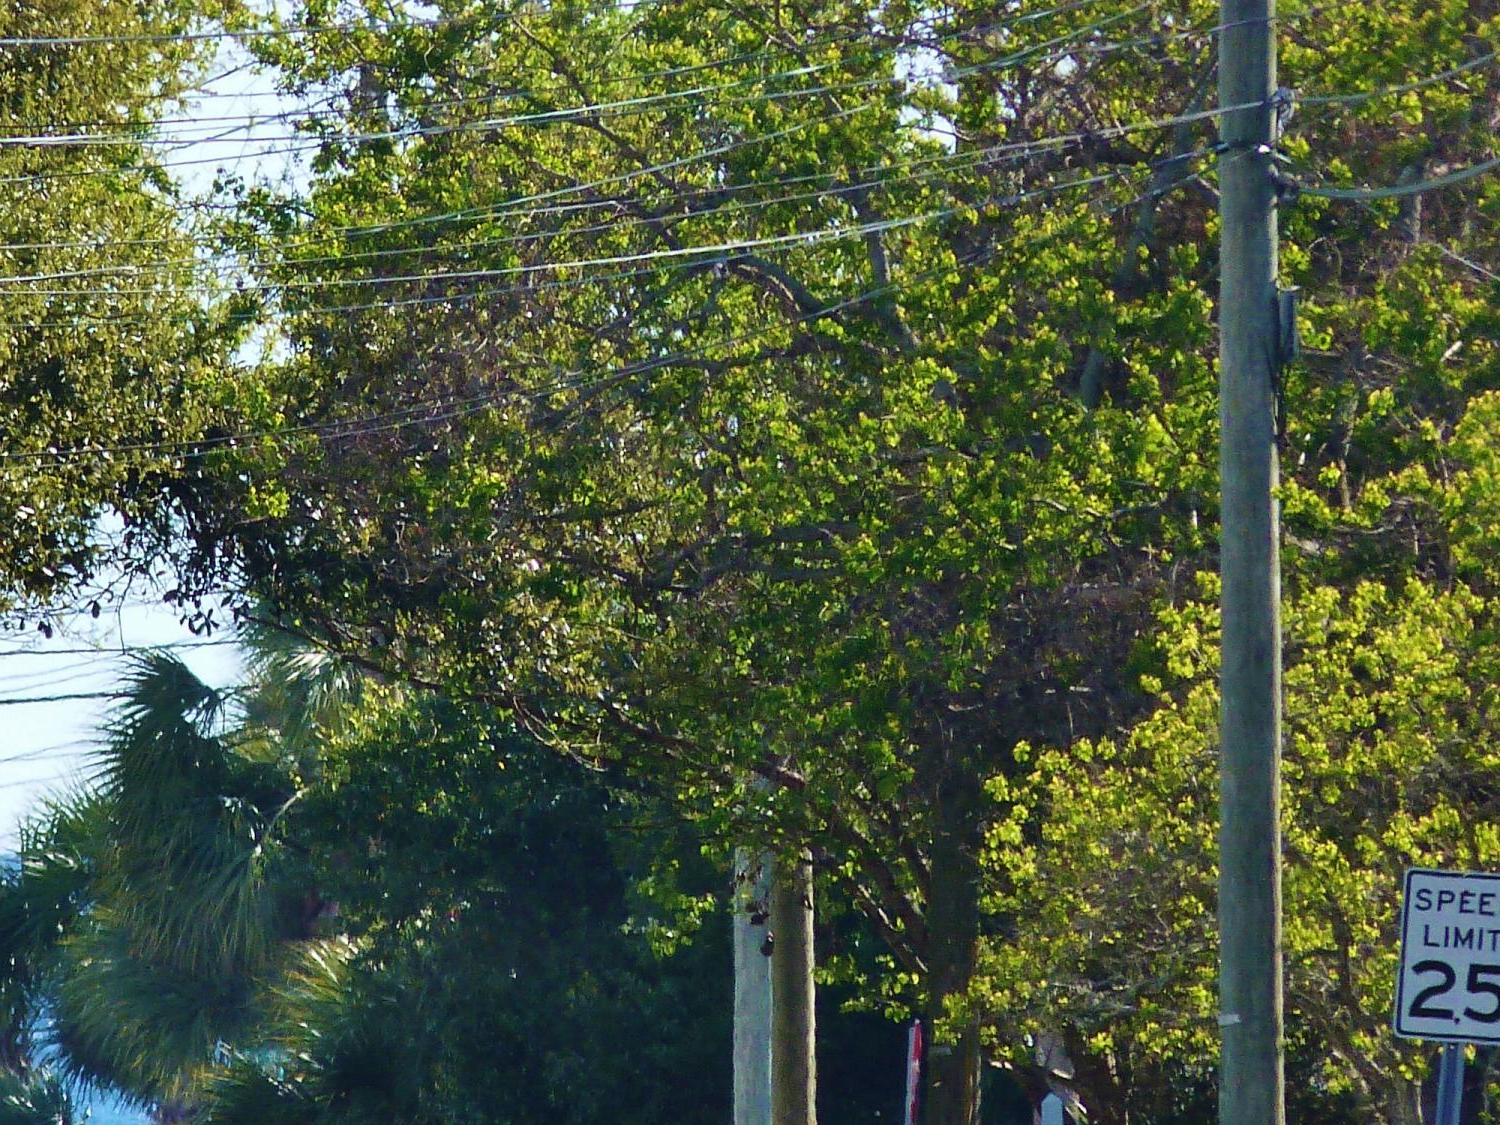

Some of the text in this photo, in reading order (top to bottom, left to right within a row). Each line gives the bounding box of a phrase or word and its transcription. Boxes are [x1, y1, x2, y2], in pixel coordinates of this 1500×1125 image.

[1414, 888, 1500, 917] SPEE
[1423, 924, 1500, 951] LIMIT
[1408, 960, 1500, 1023] 25
